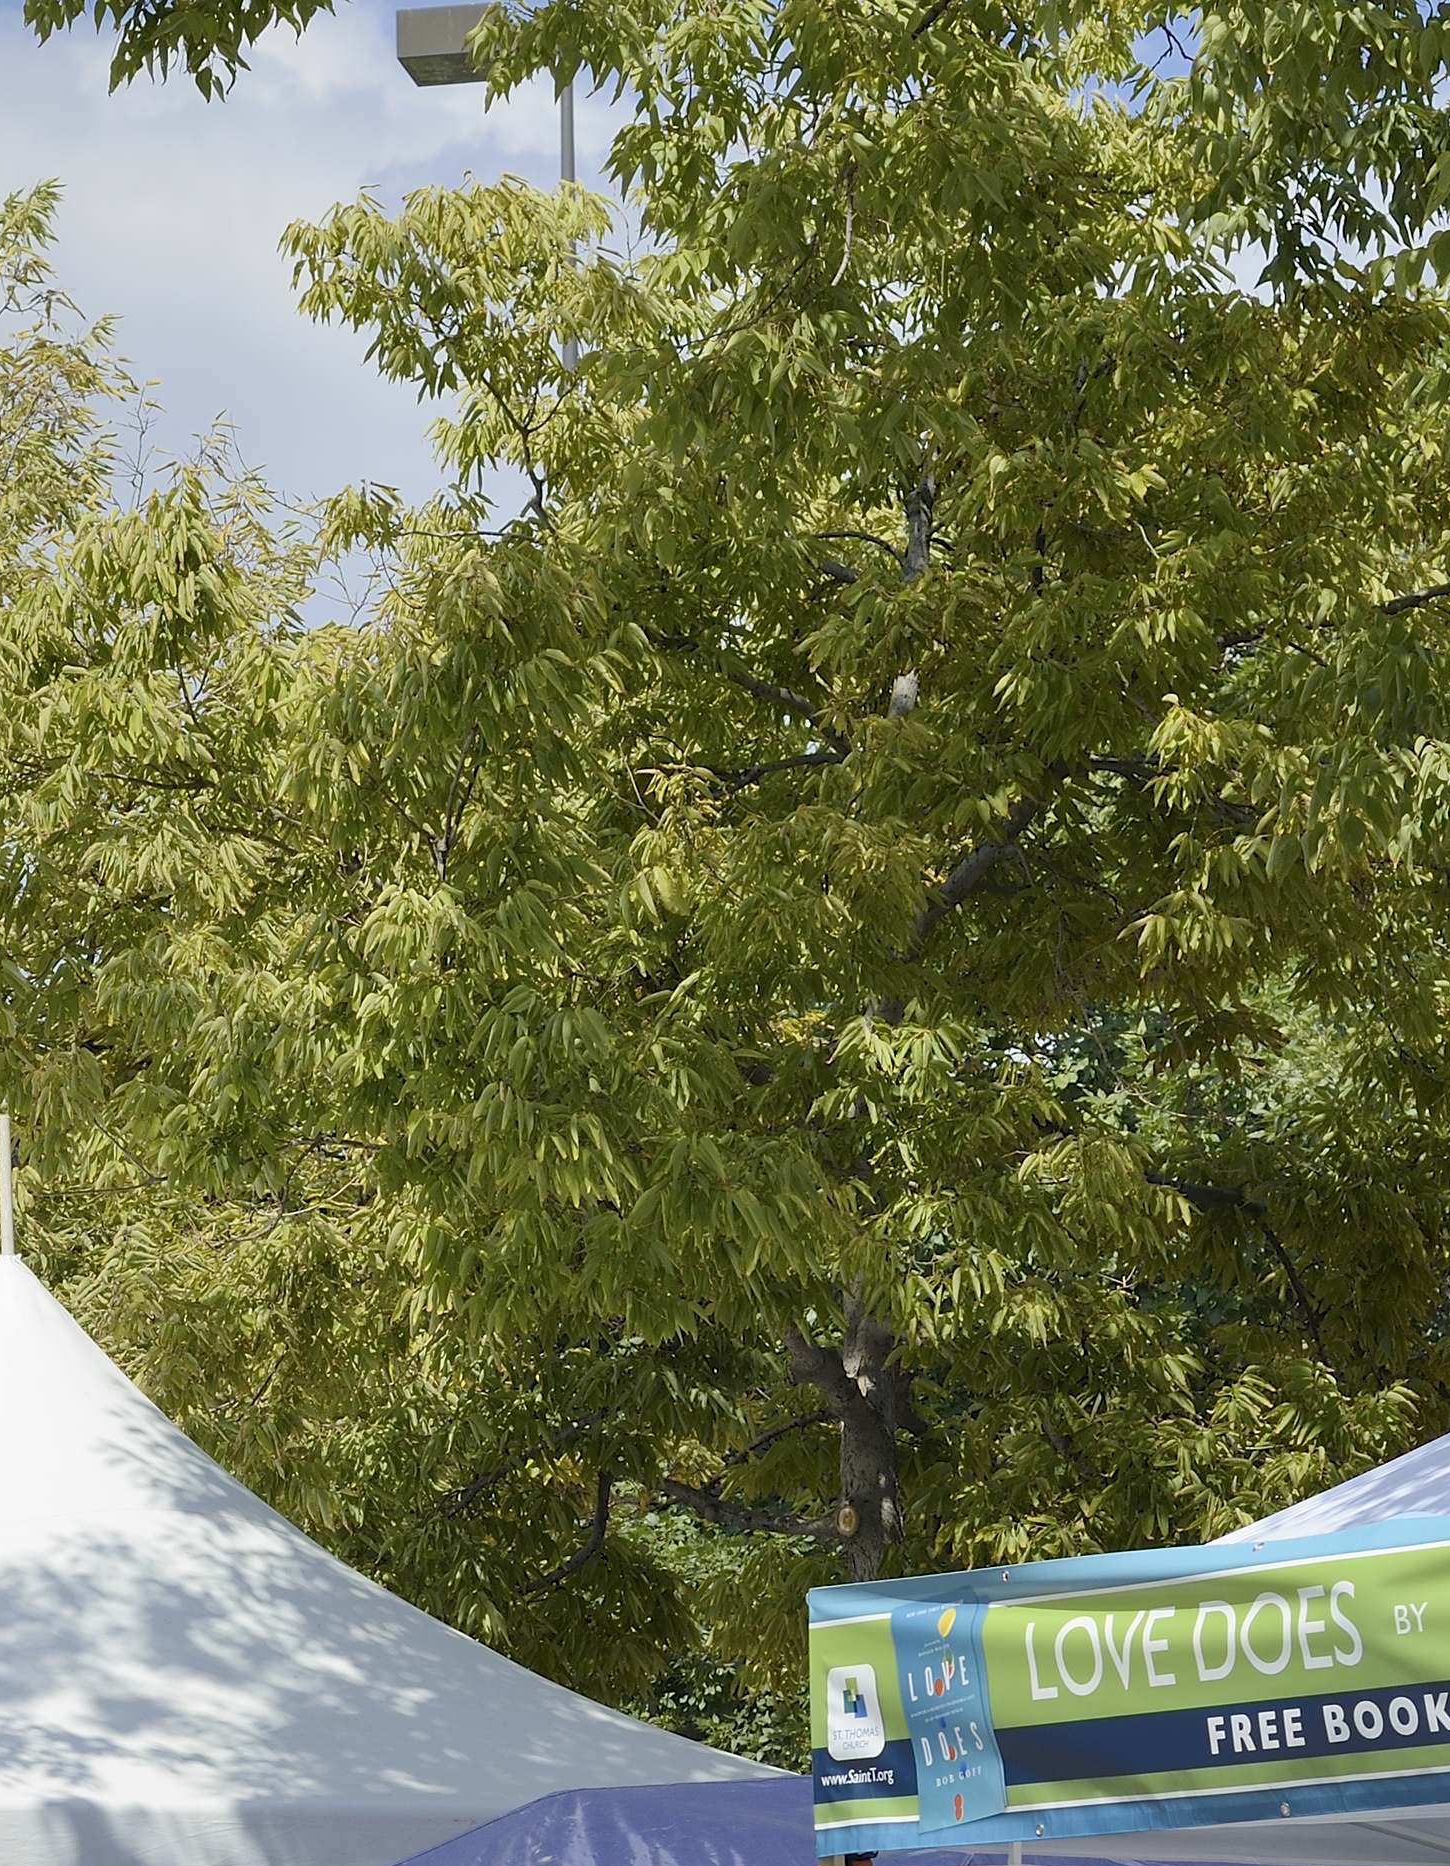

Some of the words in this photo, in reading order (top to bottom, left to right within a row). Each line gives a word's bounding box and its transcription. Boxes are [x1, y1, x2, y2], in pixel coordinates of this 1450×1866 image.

[1024, 1604, 1178, 1703] LOVE
[1190, 1582, 1365, 1684] DOES
[1393, 1601, 1429, 1635] BY
[907, 1655, 970, 1702] LOVE
[832, 1729, 844, 1741] ST.
[844, 1726, 880, 1740] THOMAS
[842, 1740, 869, 1750] CHURCH
[920, 1721, 984, 1767] DOES
[1205, 1706, 1308, 1757] FREE
[820, 1767, 895, 1787] www.SaintT.org
[935, 1774, 955, 1788] BOB
[958, 1765, 983, 1781] GOFF
